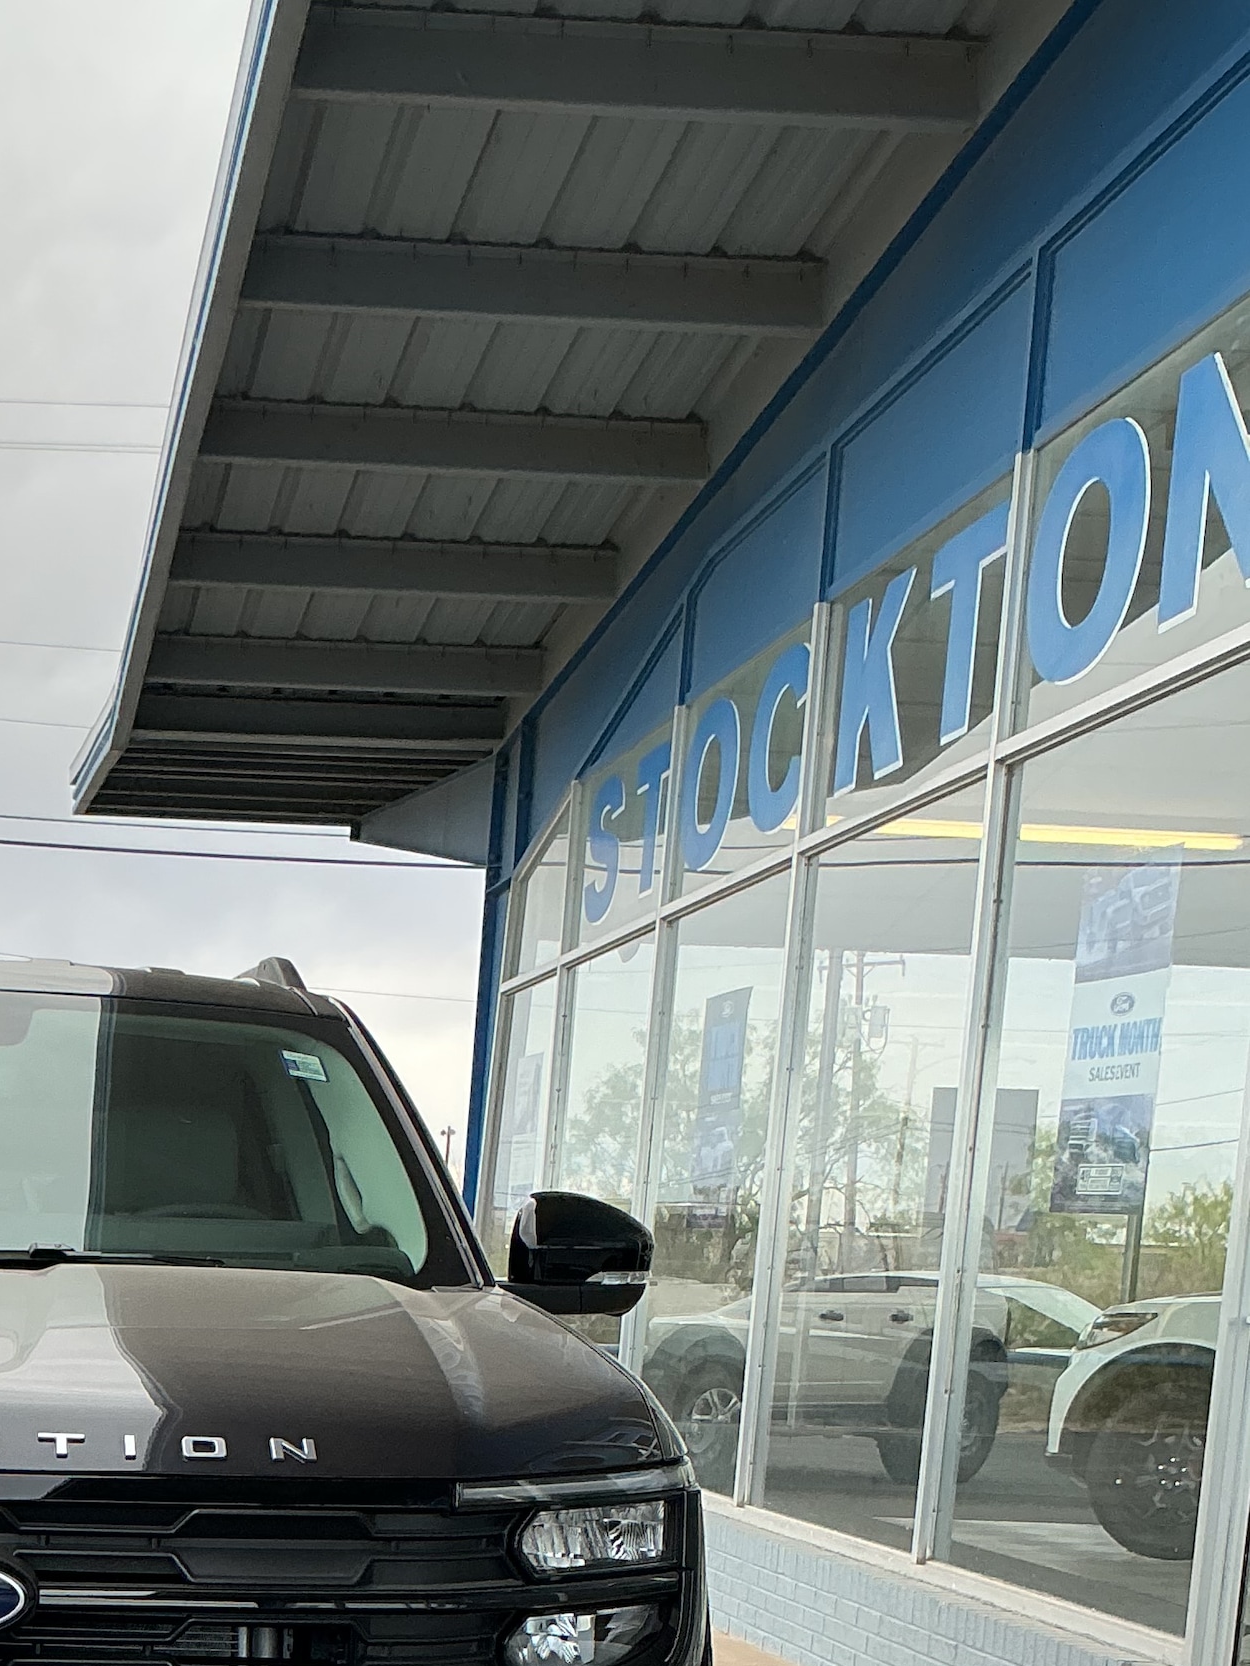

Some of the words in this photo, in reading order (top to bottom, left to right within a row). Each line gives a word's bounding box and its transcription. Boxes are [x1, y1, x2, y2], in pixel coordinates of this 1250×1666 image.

[1072, 1023, 1118, 1061] TRUCK
[1116, 1016, 1162, 1057] MONTH
[1088, 1065, 1116, 1082] SALES
[1115, 1062, 1141, 1080] EVENT
